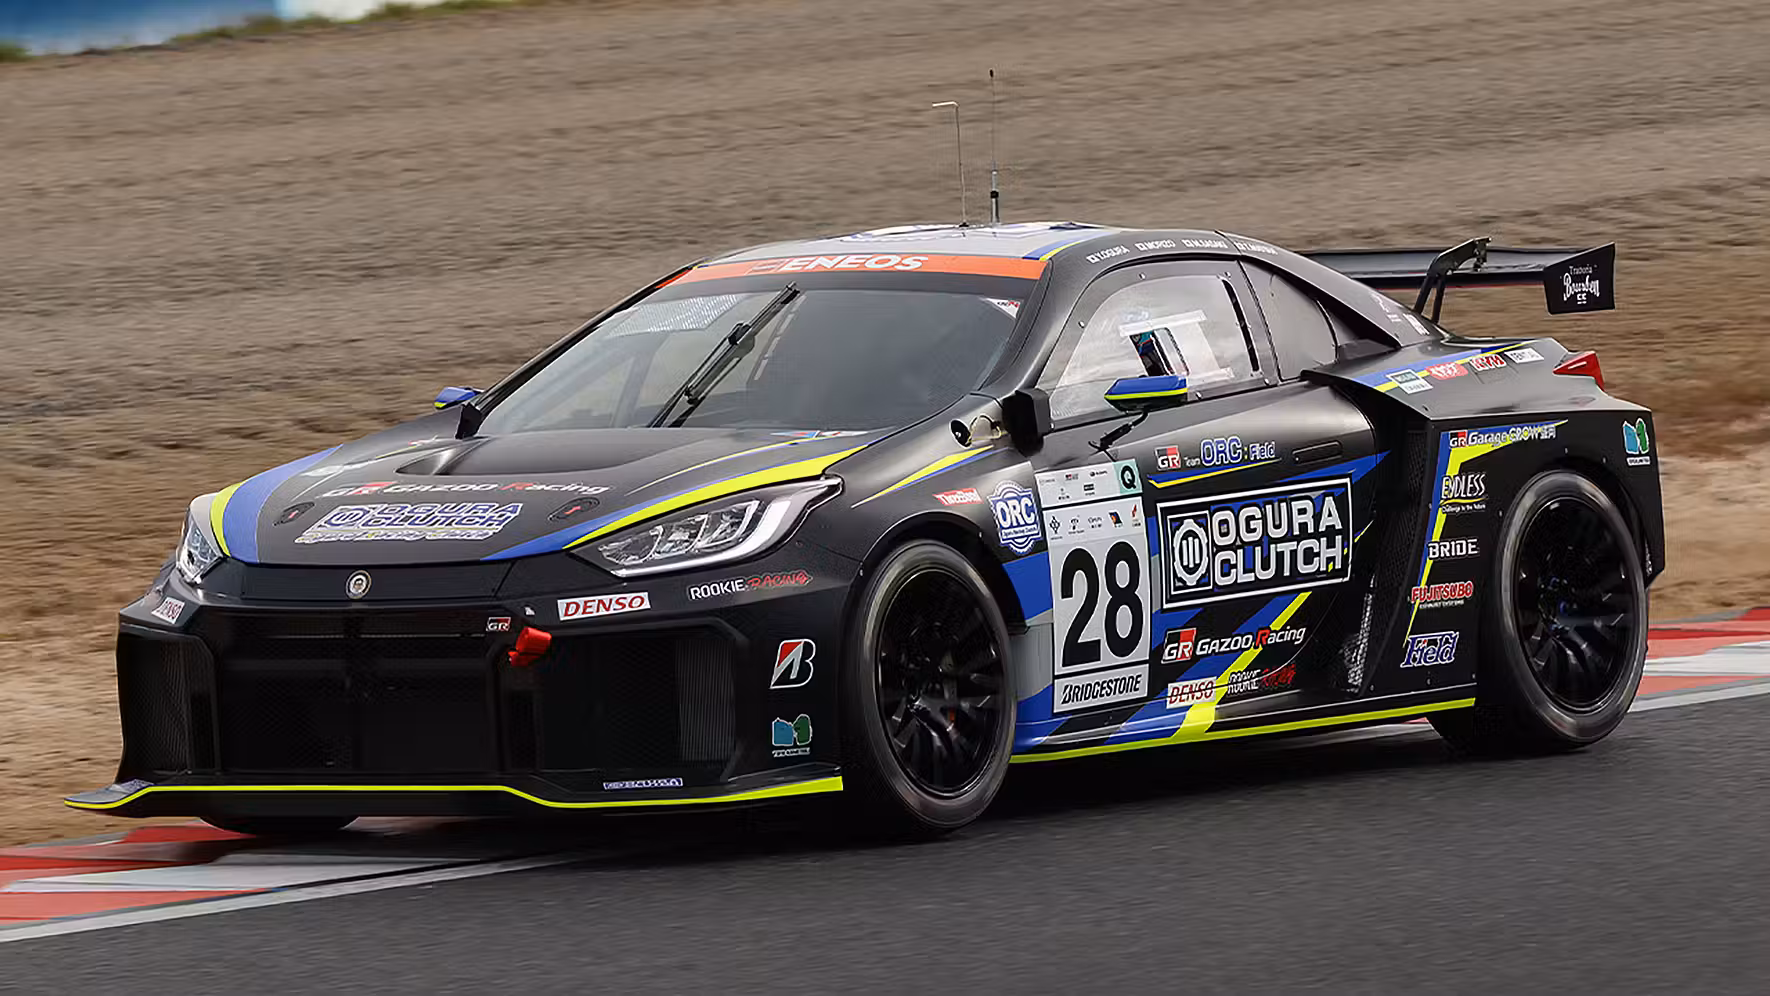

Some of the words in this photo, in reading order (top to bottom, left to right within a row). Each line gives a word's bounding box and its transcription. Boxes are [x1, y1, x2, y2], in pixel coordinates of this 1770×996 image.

[778, 255, 928, 271] ENEOS
[1468, 432, 1507, 446] Garage
[1120, 465, 1137, 490] Q
[1442, 474, 1486, 498] ENDLESS
[360, 514, 513, 528] CLUTCH
[374, 503, 523, 516] OGURA
[996, 497, 1036, 528] ORC
[1212, 496, 1343, 546] OGURA
[1214, 535, 1343, 586] CLUTCH
[1428, 539, 1478, 558] BRIDE
[690, 579, 746, 600] ROOKIE
[1411, 581, 1474, 604] FUJITSUBO
[563, 595, 645, 617] DENSO
[1061, 541, 1144, 667] 28
[1196, 634, 1253, 655] GAZOO
[1255, 626, 1306, 646] Racing
[1061, 674, 1142, 704] BRIDGESTONE
[1168, 681, 1215, 705] DENSO
